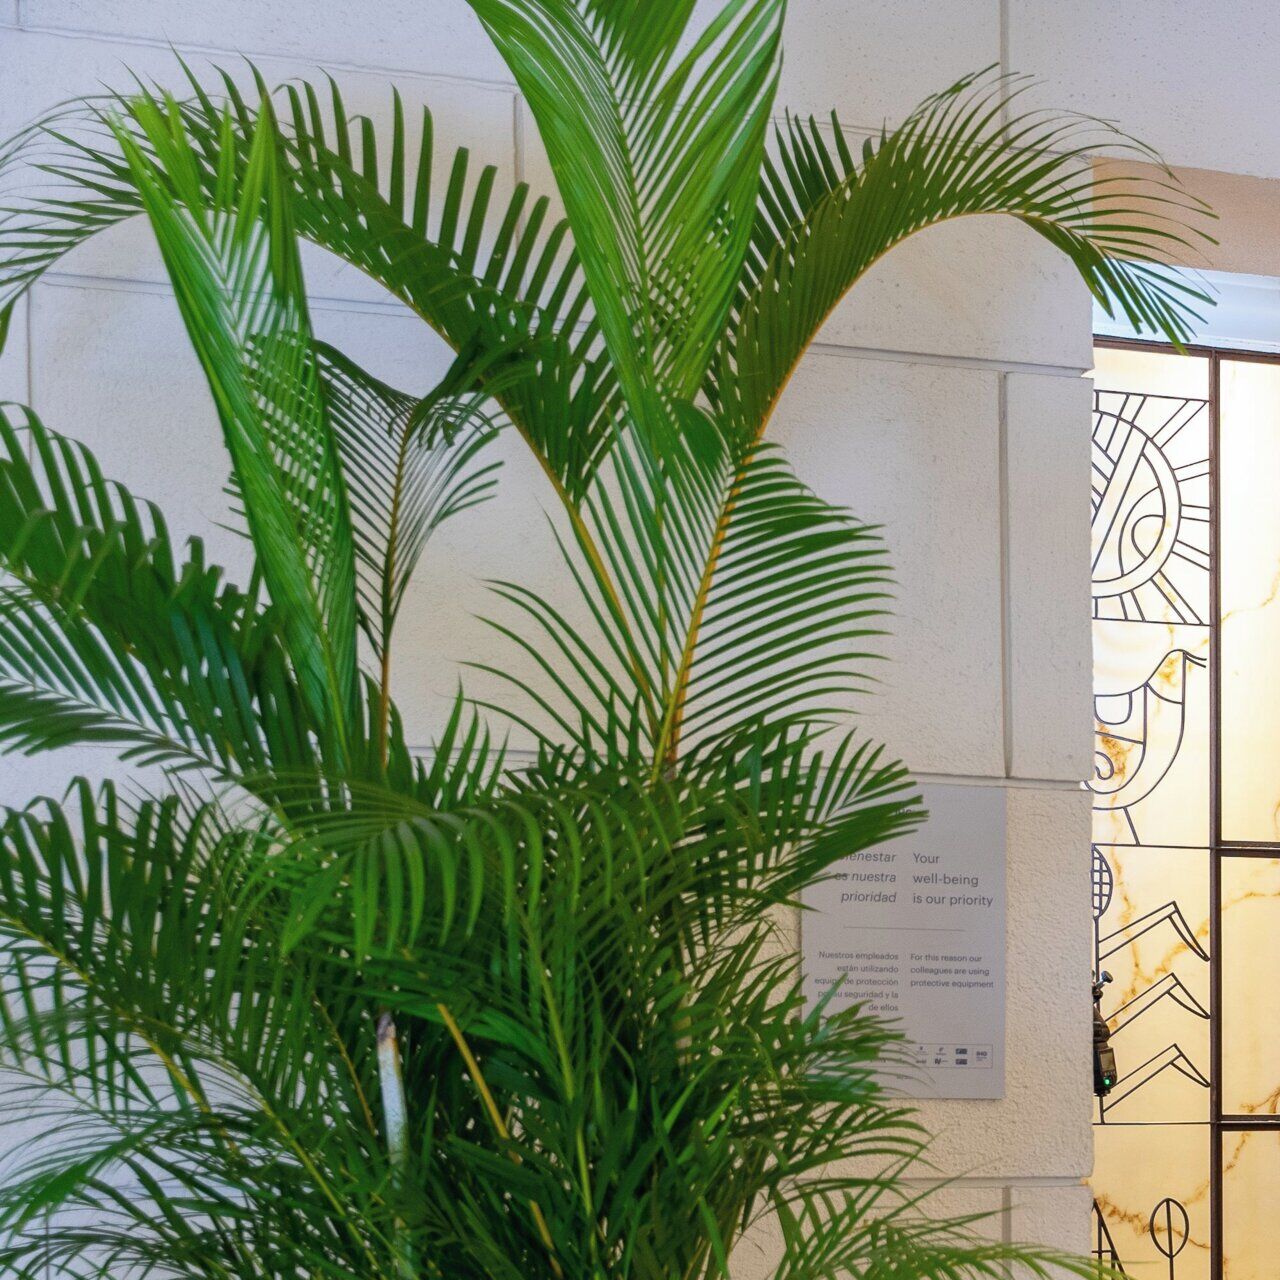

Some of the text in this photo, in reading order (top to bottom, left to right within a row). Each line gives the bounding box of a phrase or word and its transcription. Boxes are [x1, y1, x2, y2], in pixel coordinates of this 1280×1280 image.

[840, 852, 897, 863] enestar
[913, 852, 940, 864] Your
[852, 872, 897, 882] nuestra
[913, 872, 979, 888] well-being
[840, 891, 897, 903] prioridad
[913, 892, 994, 908] is our priority
[819, 951, 899, 961] Nuestros empleados
[925, 953, 939, 961] this
[941, 954, 967, 962] reason
[860, 965, 899, 973] utilizando
[910, 966, 952, 975] colleagues
[968, 968, 990, 976] using
[814, 977, 840, 986] equip
[910, 979, 950, 987] protective
[844, 991, 884, 999] seguridad
[891, 991, 899, 999] la
[868, 1004, 899, 1012] de ellos
